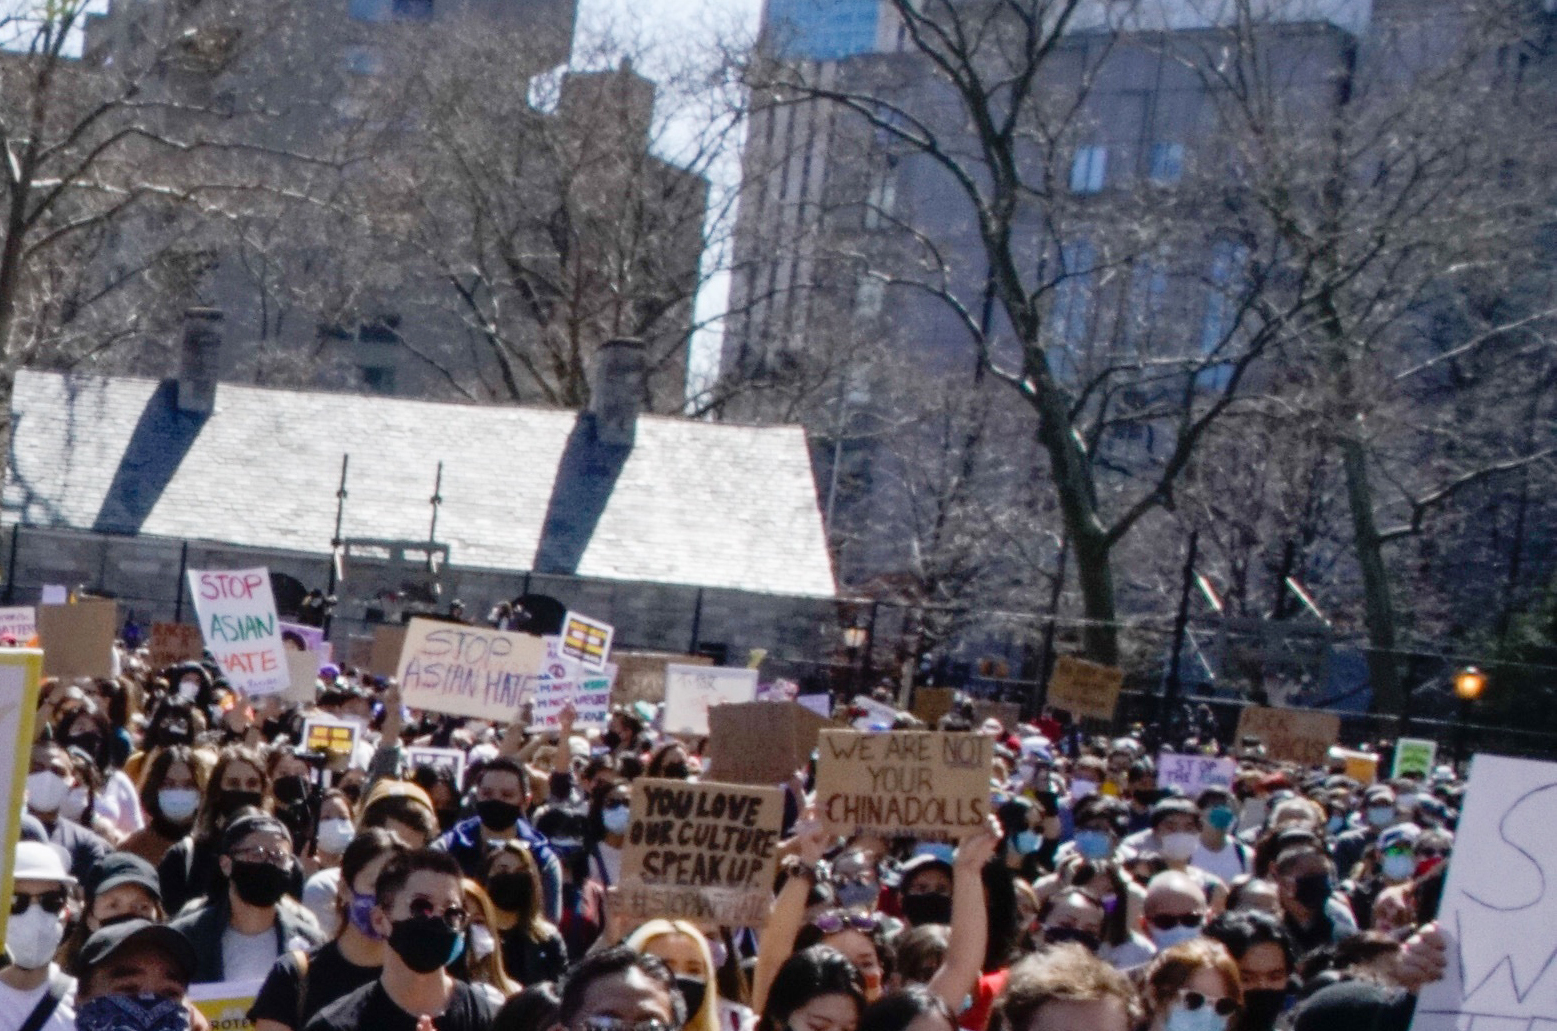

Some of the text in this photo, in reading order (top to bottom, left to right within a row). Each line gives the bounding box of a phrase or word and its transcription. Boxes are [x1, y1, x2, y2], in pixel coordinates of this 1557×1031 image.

[201, 573, 262, 600] STOP
[210, 612, 274, 642] ASIAN
[215, 650, 278, 673] HATE
[422, 630, 513, 666] STOP
[402, 657, 538, 708] ASIAN HATE
[826, 735, 985, 766] WE ARE NOT
[868, 765, 933, 793] YOUR
[644, 785, 762, 826] YOU LOVE
[826, 793, 984, 826] CHINADOLLS
[677, 821, 778, 858] CULTURE
[641, 851, 725, 886] SPEAK
